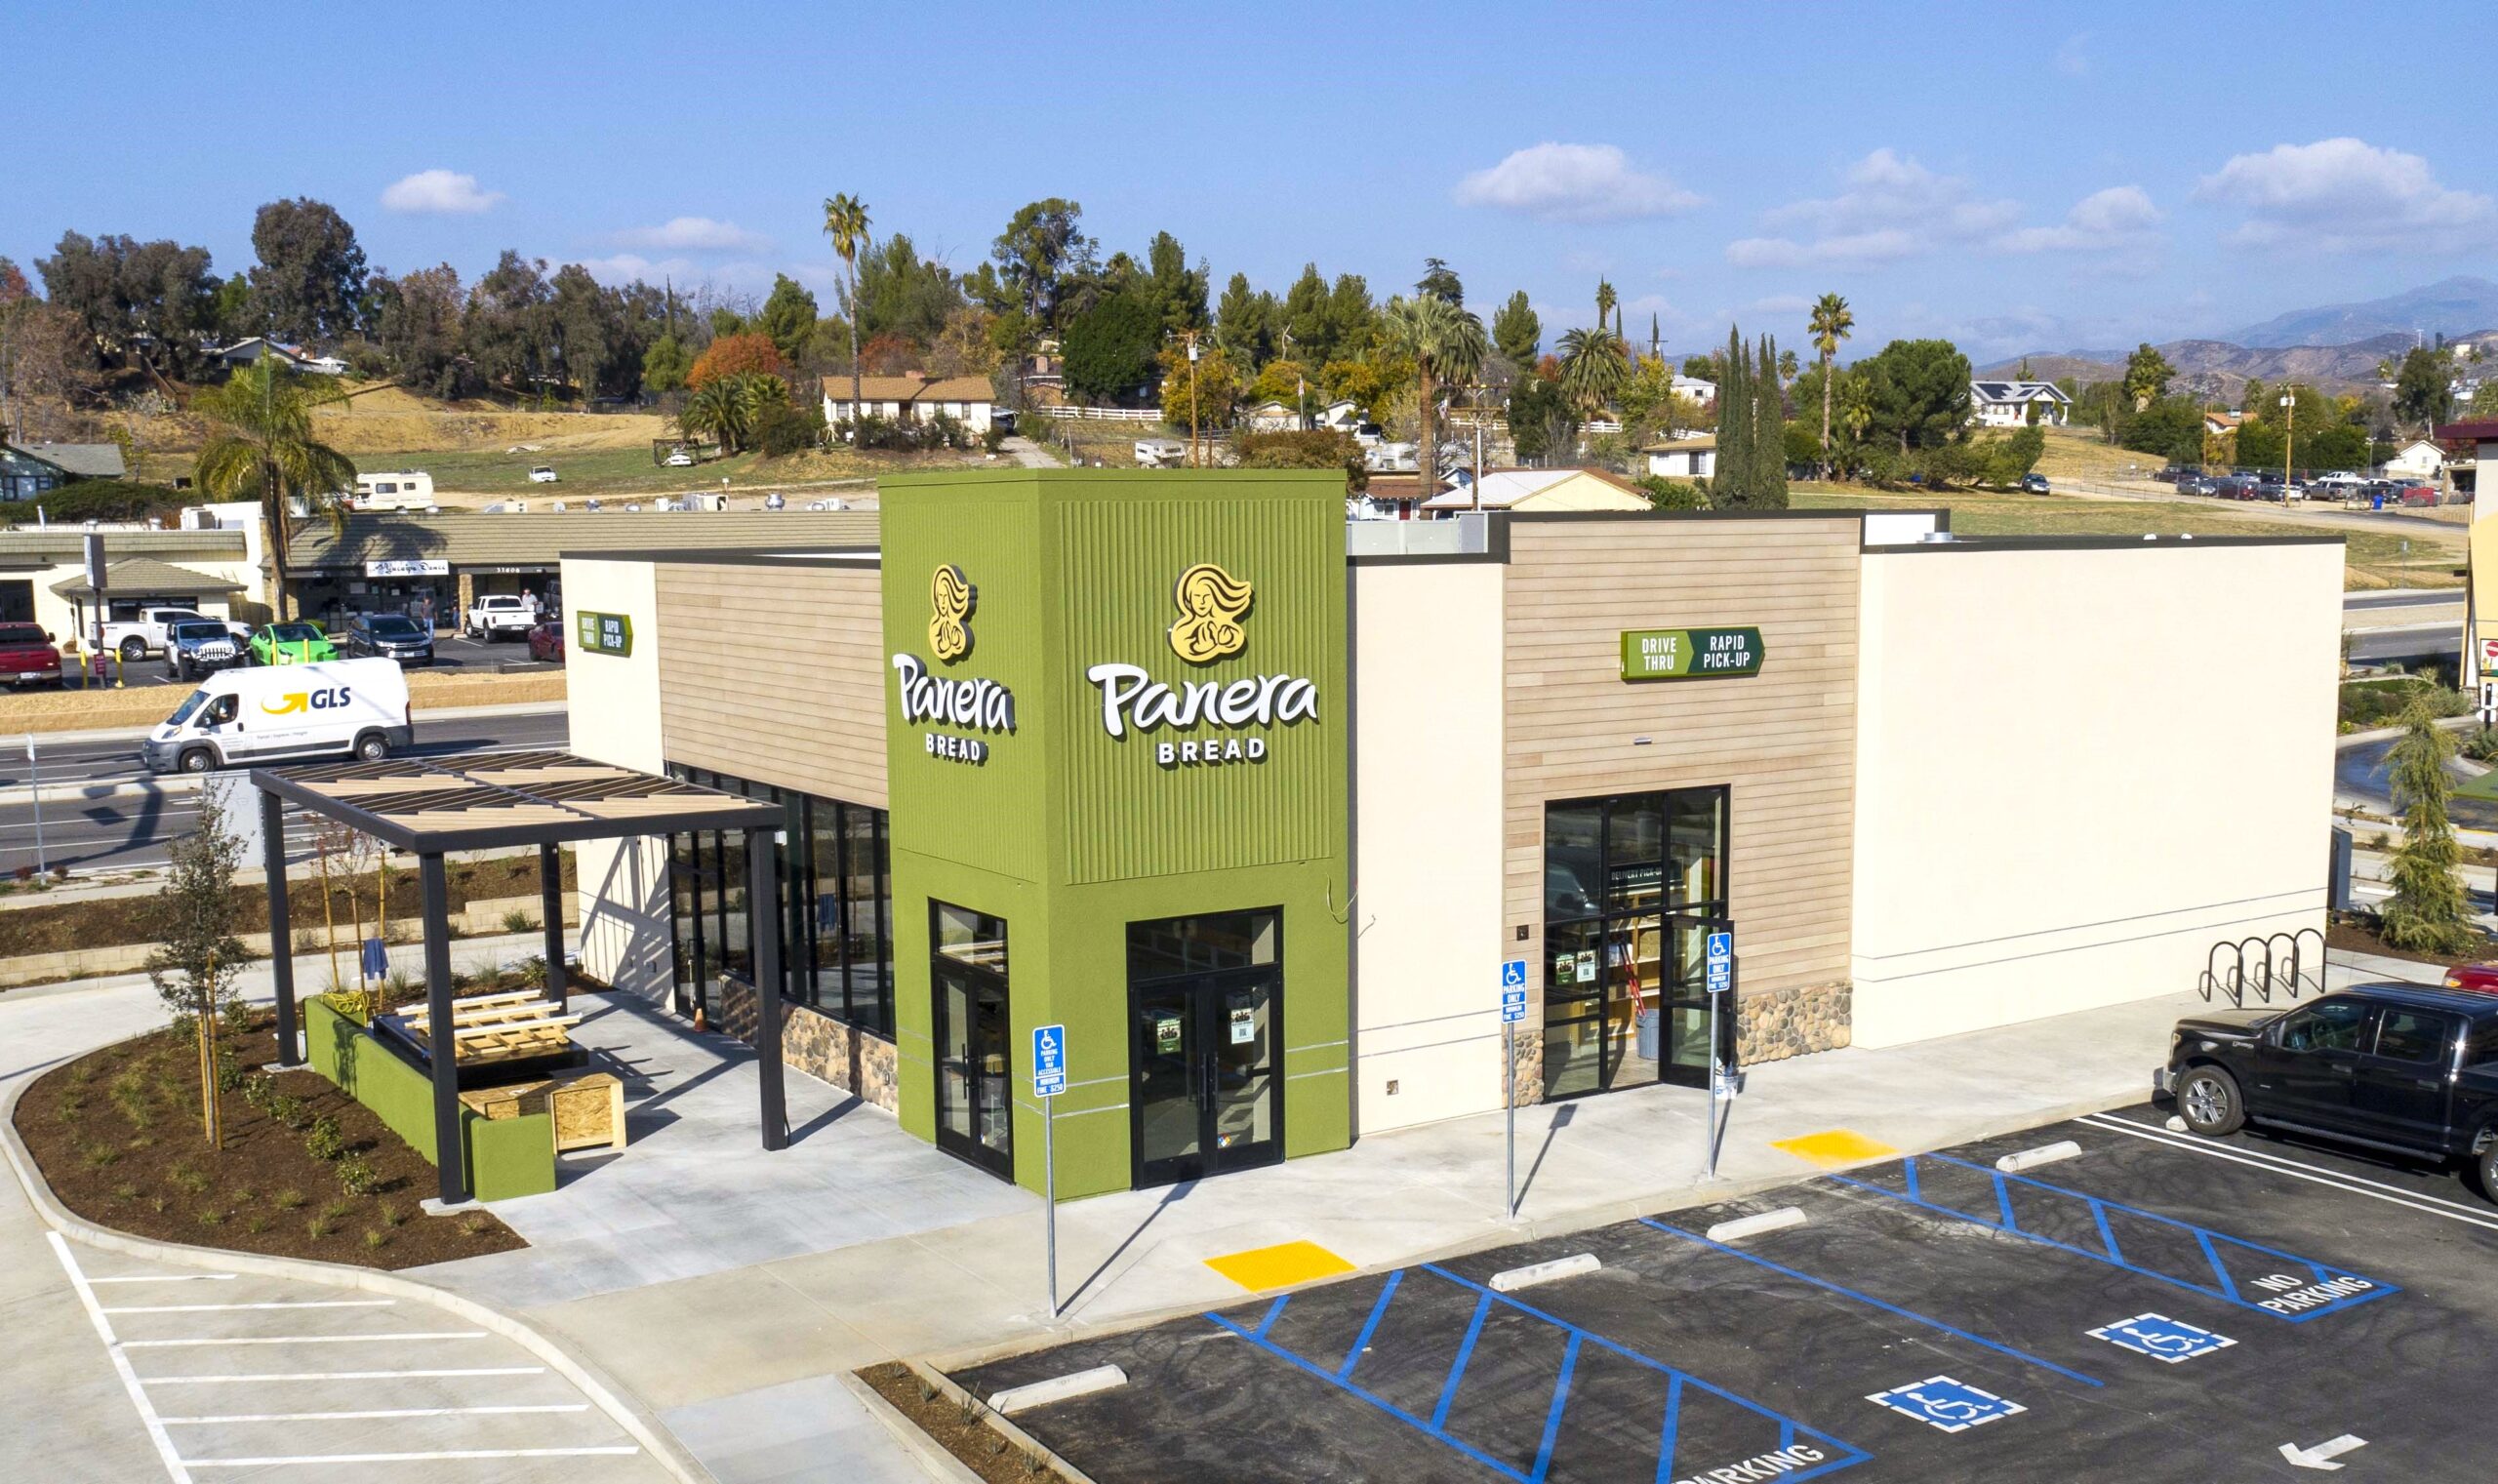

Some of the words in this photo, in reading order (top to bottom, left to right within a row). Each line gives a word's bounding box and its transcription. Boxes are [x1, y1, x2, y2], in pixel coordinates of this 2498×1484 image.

[604, 620, 619, 634] RAPID
[603, 633, 623, 648] PICK-UP
[1641, 637, 1677, 654] DRIVE
[1710, 635, 1745, 651] RAPID
[1643, 655, 1674, 671] THRU
[1704, 652, 1751, 668] PICK-UP
[310, 687, 351, 709] GLS
[892, 653, 1011, 731] Panera
[1087, 663, 1318, 738] Panera
[925, 733, 982, 762] BREAD
[1158, 738, 1266, 764] BREAD
[1611, 868, 1639, 881] DELIVERY
[1639, 866, 1662, 878] PICK-U
[1709, 954, 1729, 965] PARKING
[1712, 964, 1725, 974] ONLY
[1503, 983, 1525, 994] PARKING
[1507, 992, 1521, 1003] ONLY
[1040, 1048, 1059, 1057] PARKING
[1038, 1066, 1062, 1076] ACCESSIBLE
[2250, 1273, 2304, 1292] NO
[2256, 1276, 2373, 1314] PARKING
